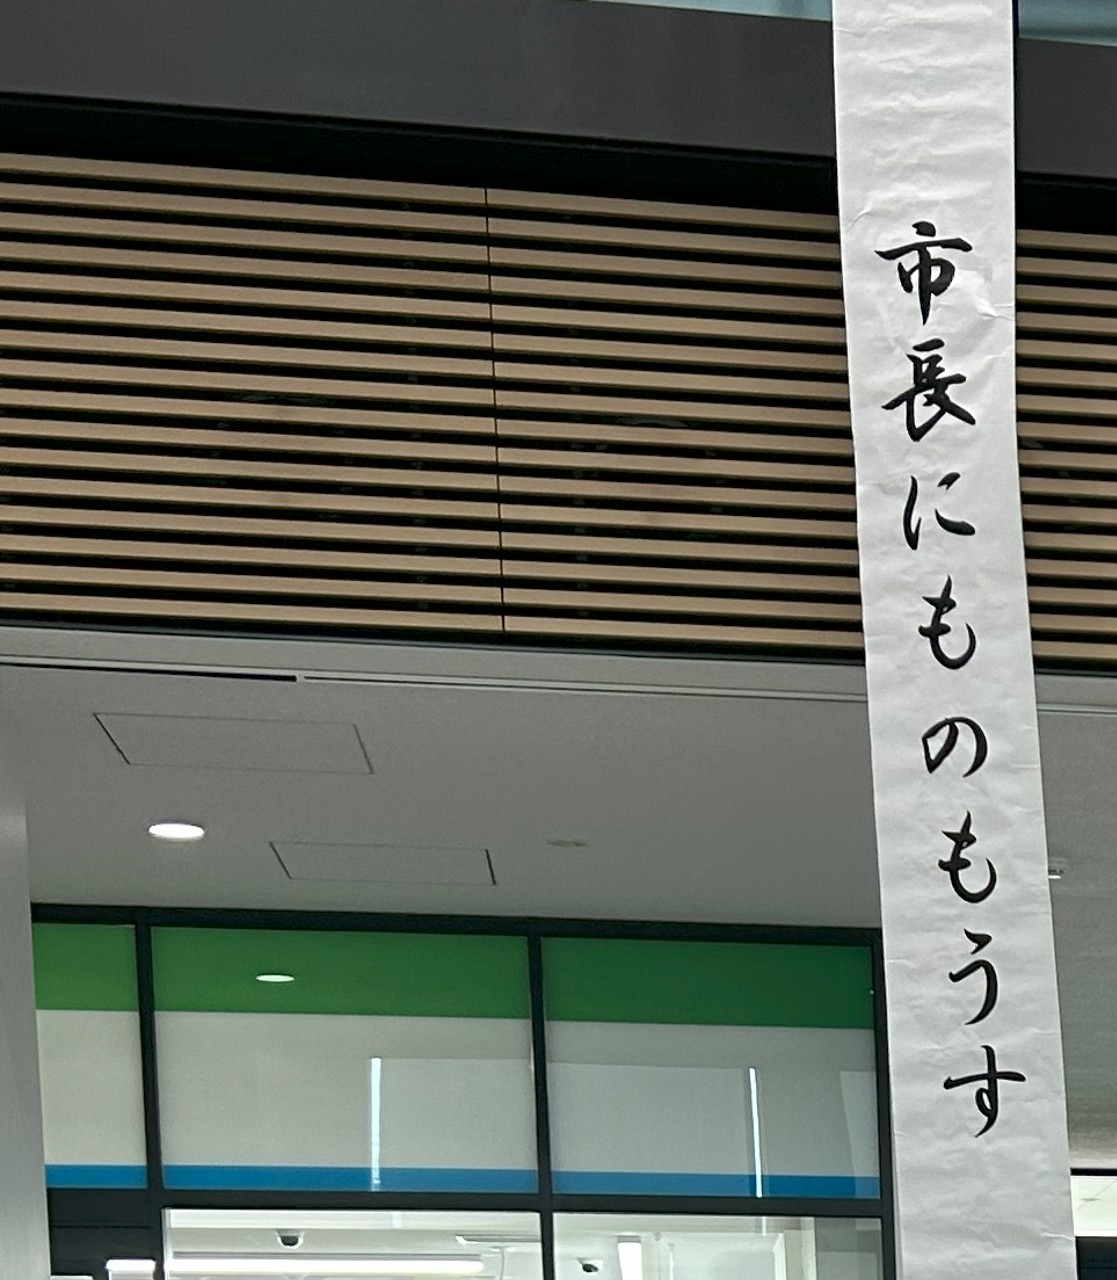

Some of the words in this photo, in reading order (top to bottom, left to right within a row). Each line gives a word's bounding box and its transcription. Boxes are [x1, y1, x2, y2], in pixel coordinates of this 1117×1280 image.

[874, 220, 1027, 1138] 市長にものもうす
